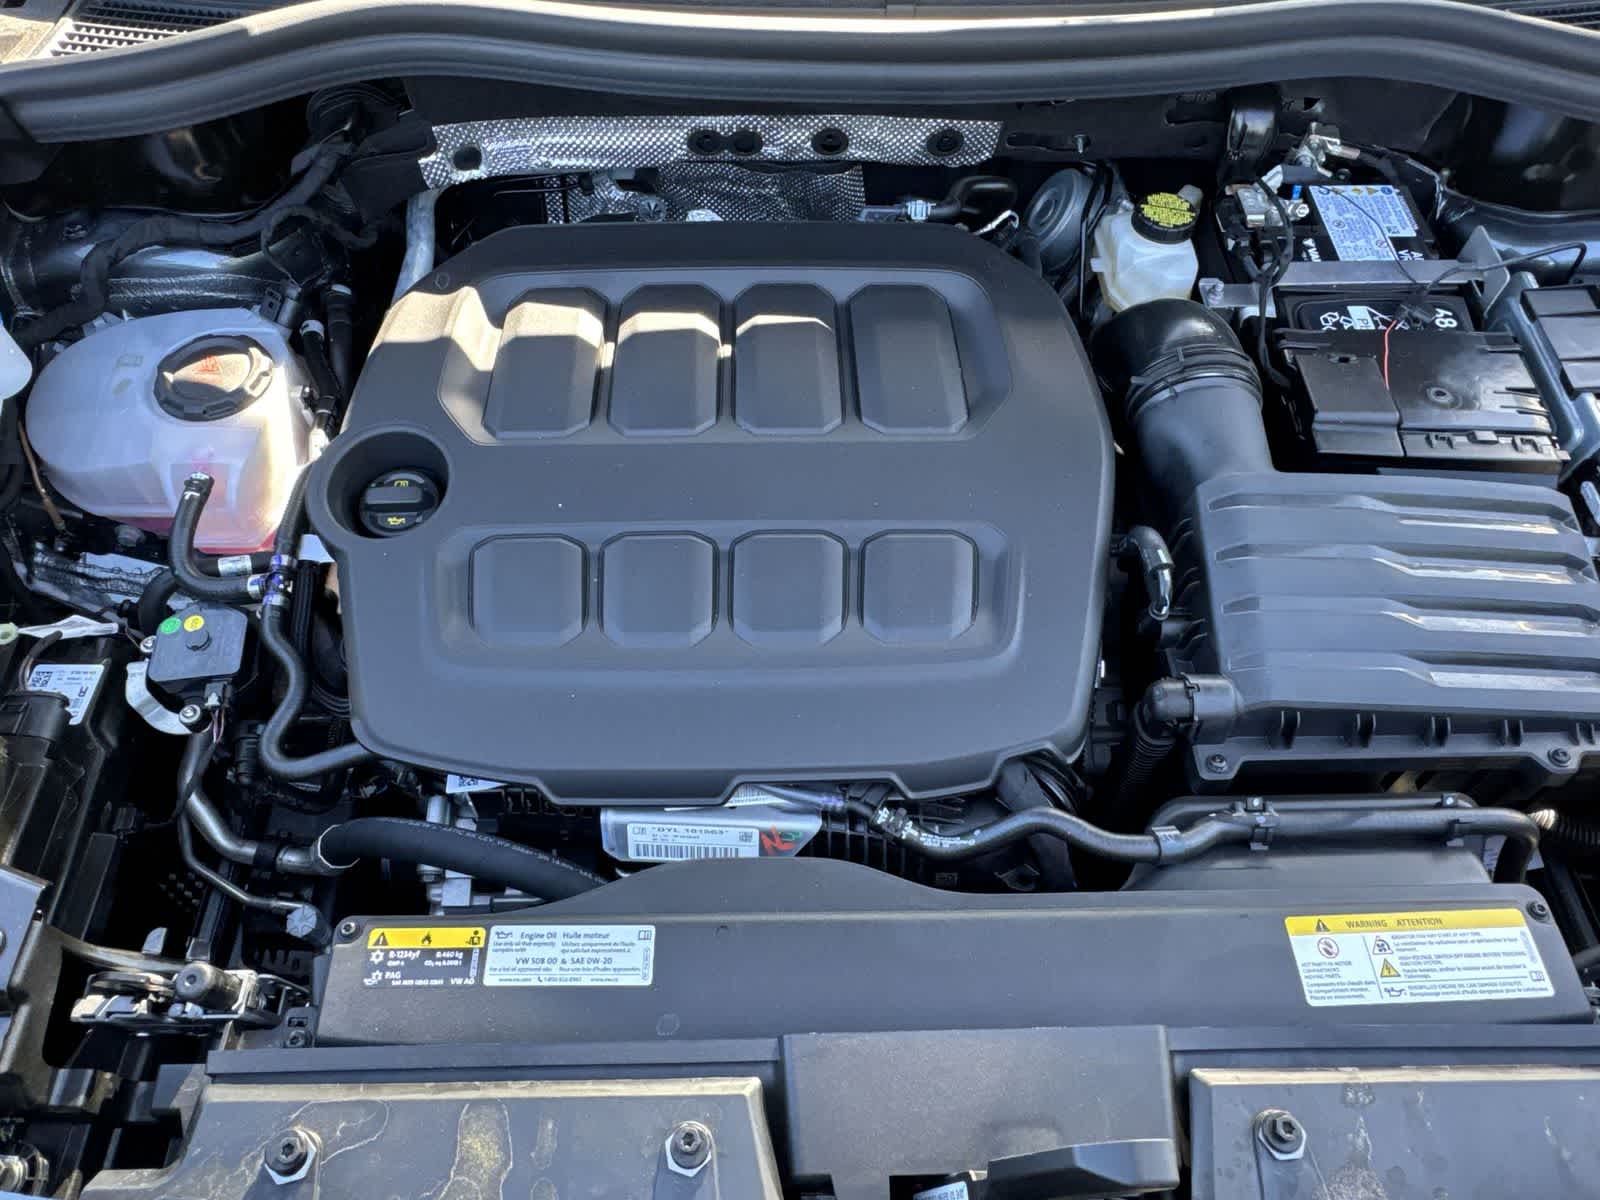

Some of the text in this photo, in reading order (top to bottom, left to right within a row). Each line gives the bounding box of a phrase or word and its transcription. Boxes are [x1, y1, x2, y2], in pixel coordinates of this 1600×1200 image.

[1344, 917, 1443, 929] WARNING ATTENTION
[520, 932, 545, 941] Engine
[546, 931, 557, 940] Oil
[562, 931, 582, 940] Huile
[515, 957, 530, 965] VW
[531, 957, 546, 965] 508
[546, 957, 558, 965] 00
[570, 957, 585, 965] SAE
[586, 957, 613, 965] 0W-20
[384, 970, 401, 979] PAG
[450, 977, 464, 985] VW
